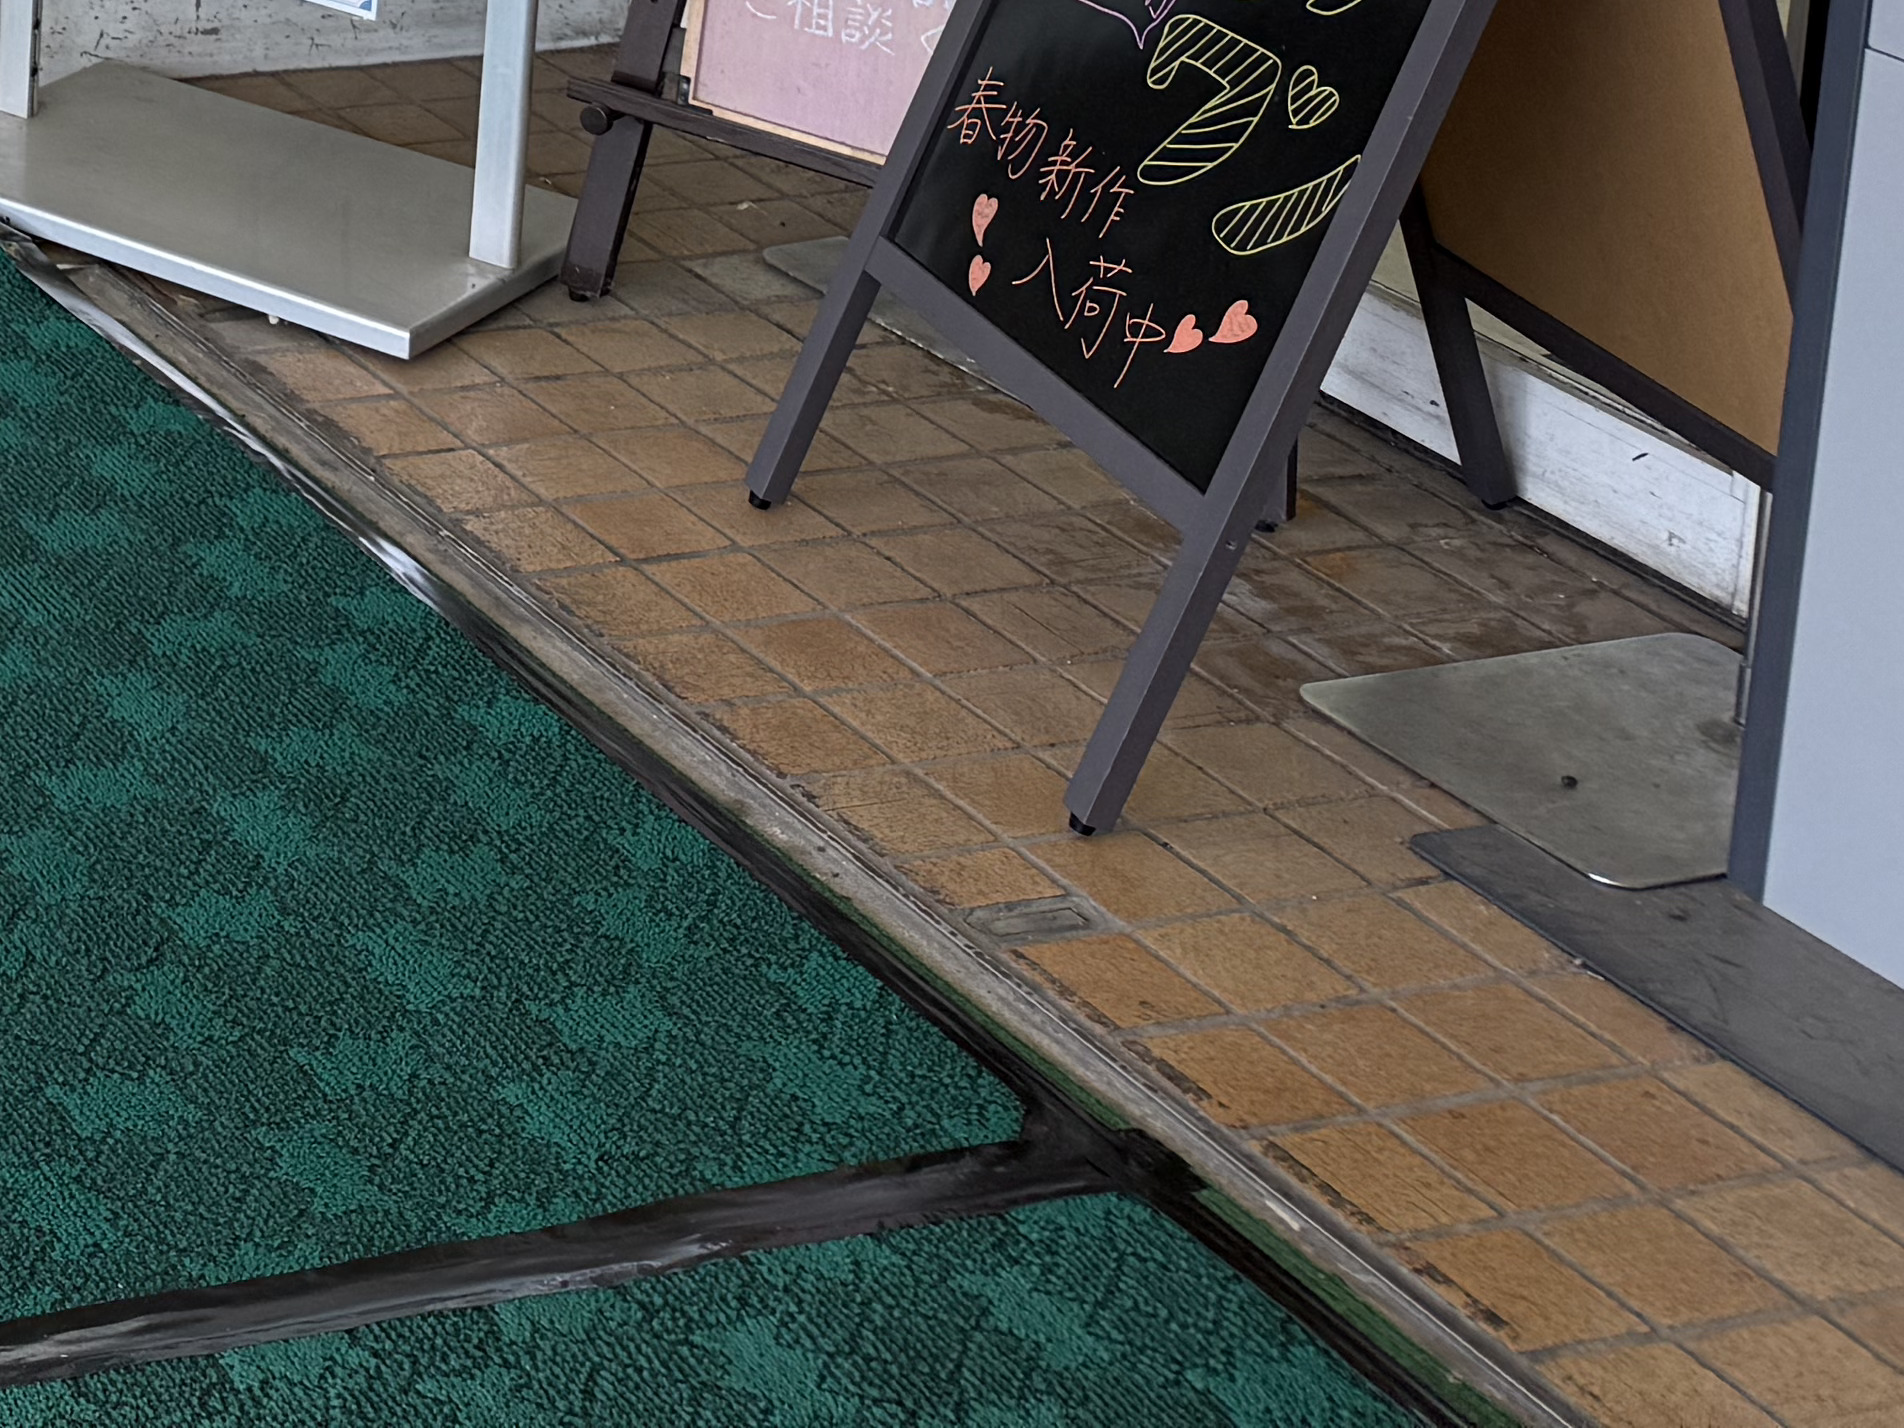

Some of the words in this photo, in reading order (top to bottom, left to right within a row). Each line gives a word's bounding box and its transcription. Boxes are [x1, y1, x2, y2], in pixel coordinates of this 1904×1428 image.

[952, 74, 1135, 240] 春物新作
[1011, 250, 1169, 389] 入荷中
